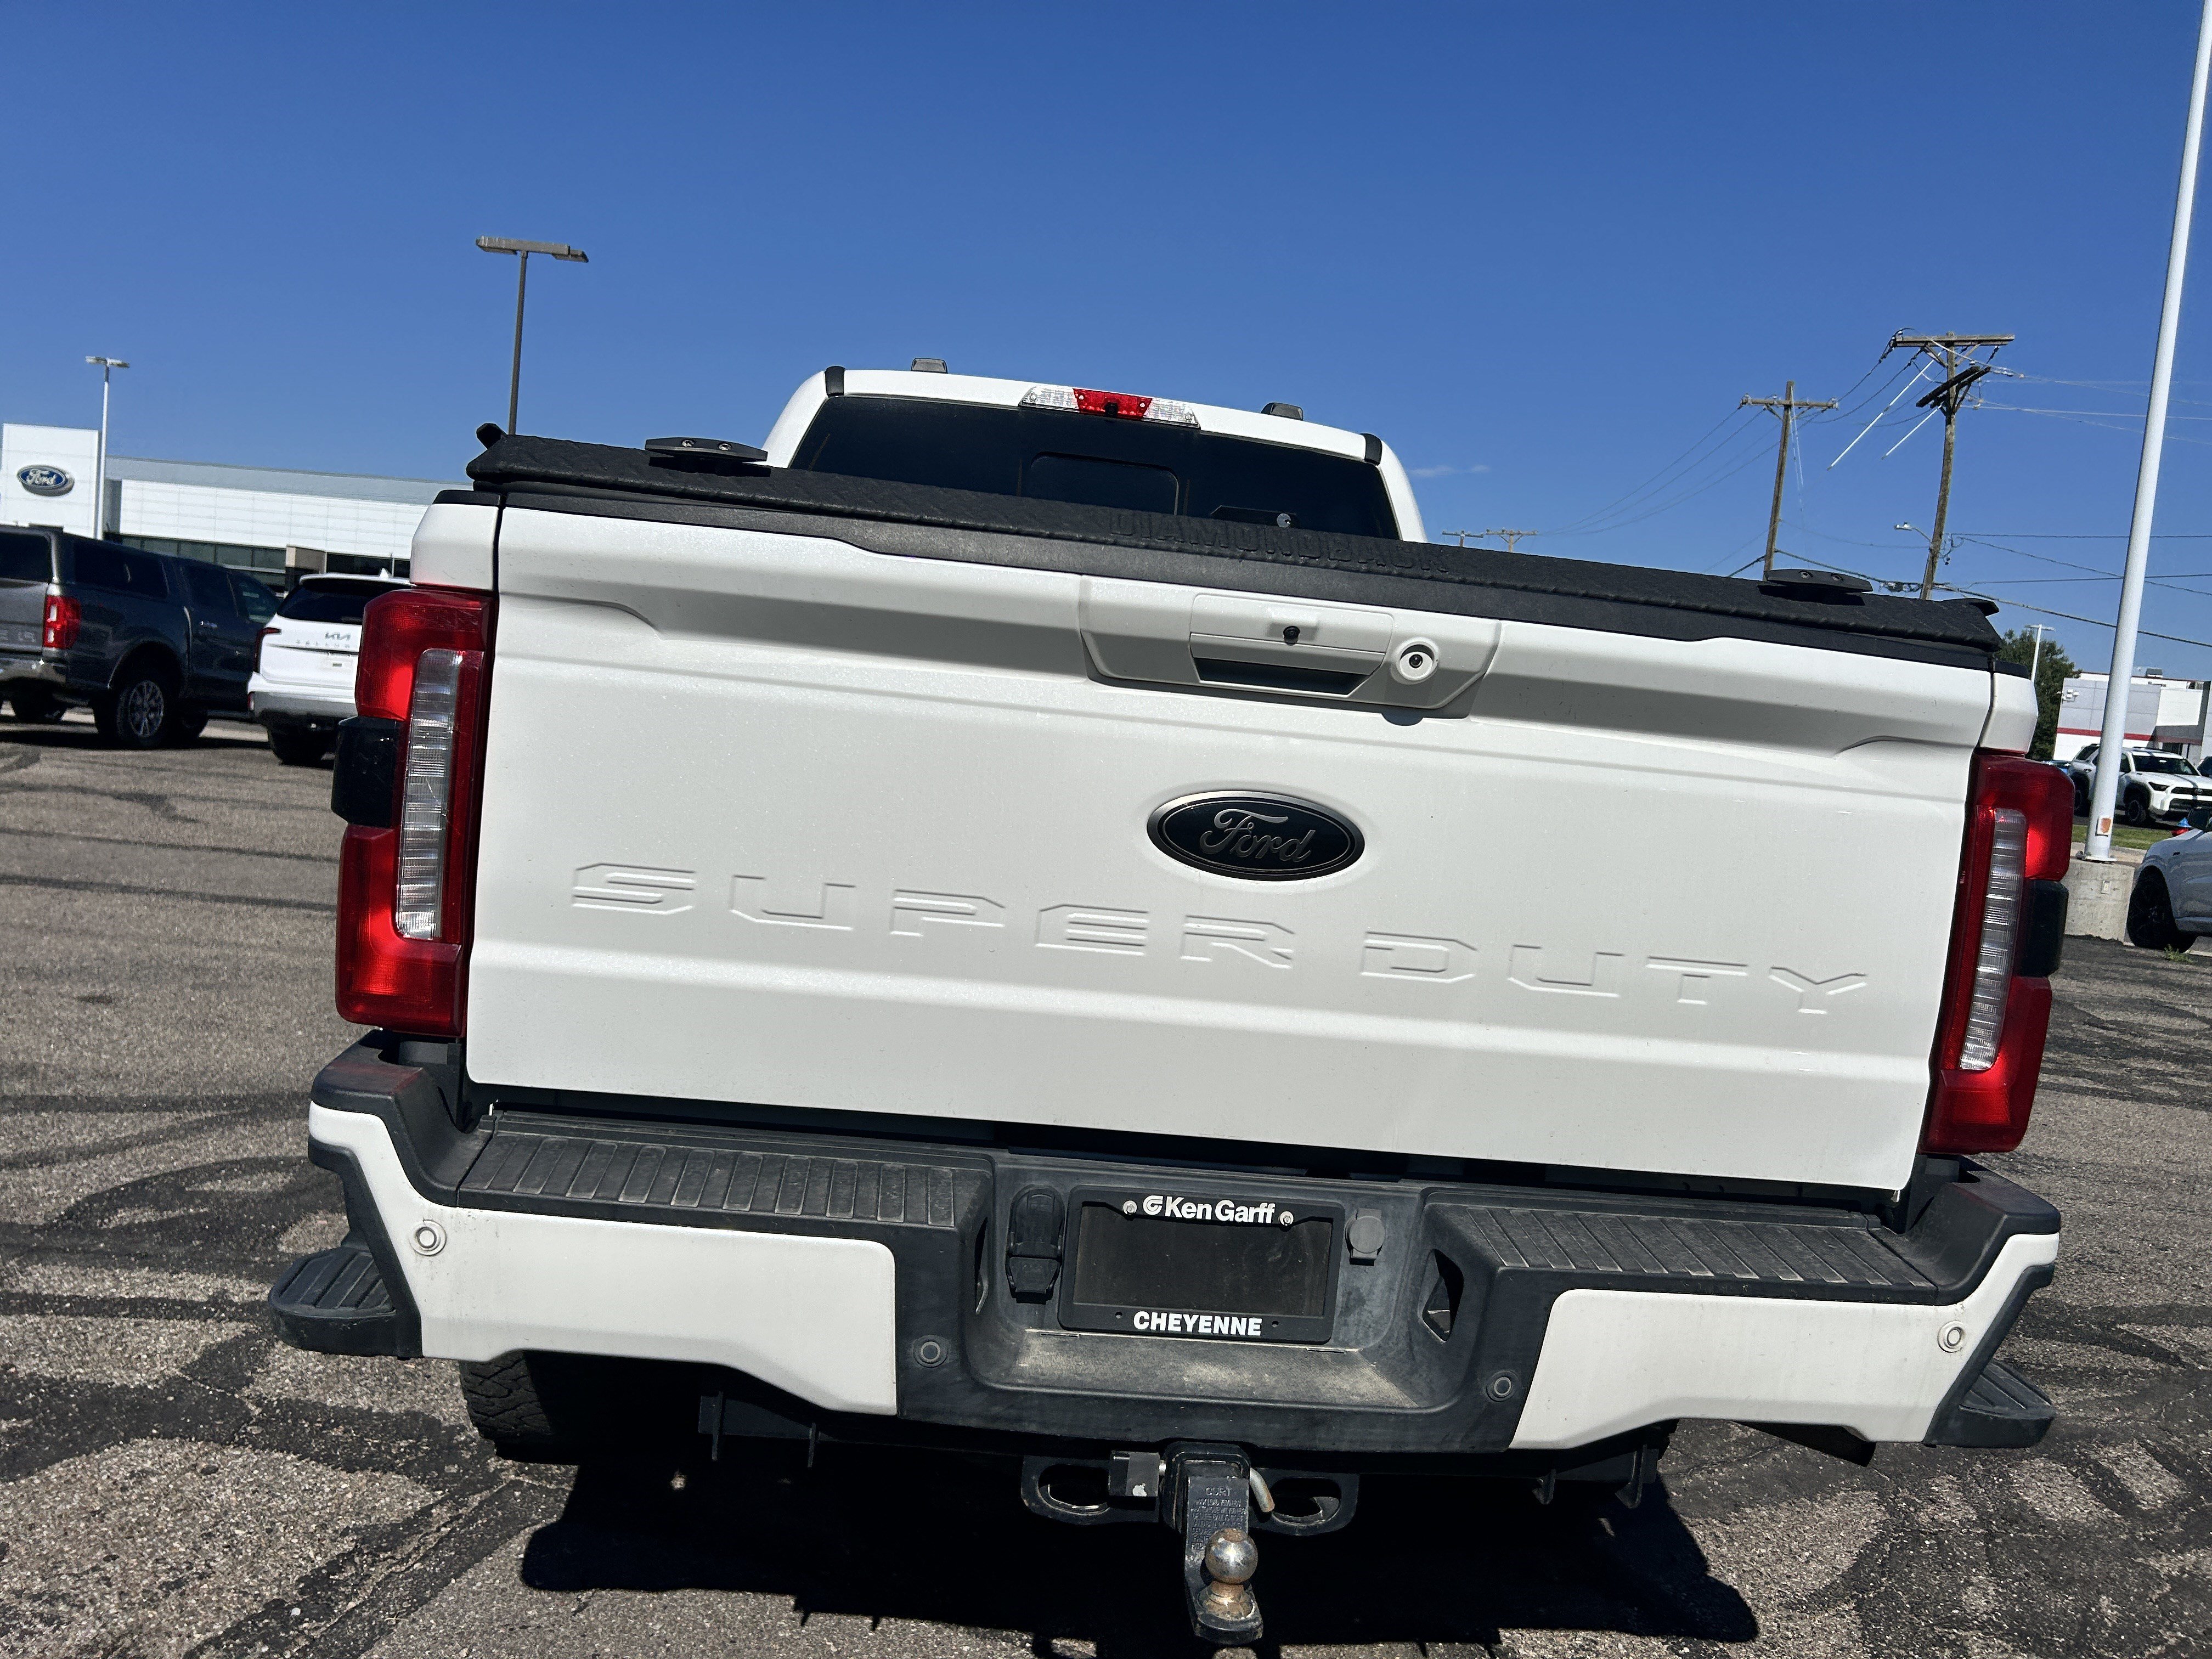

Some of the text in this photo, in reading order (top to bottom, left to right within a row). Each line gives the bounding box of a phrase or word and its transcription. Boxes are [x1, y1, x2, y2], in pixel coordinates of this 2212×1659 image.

[26, 469, 57, 485] Ford
[1109, 510, 1449, 573] DIAMONDBACK
[1199, 808, 1316, 863] Ford
[572, 862, 1867, 1015] SUPER DUTY
[1165, 1195, 1212, 1220] Ken
[1215, 1199, 1276, 1223] Garff
[1133, 1310, 1263, 1336] CHEYENNE
[1205, 1486, 1233, 1497] CURT
